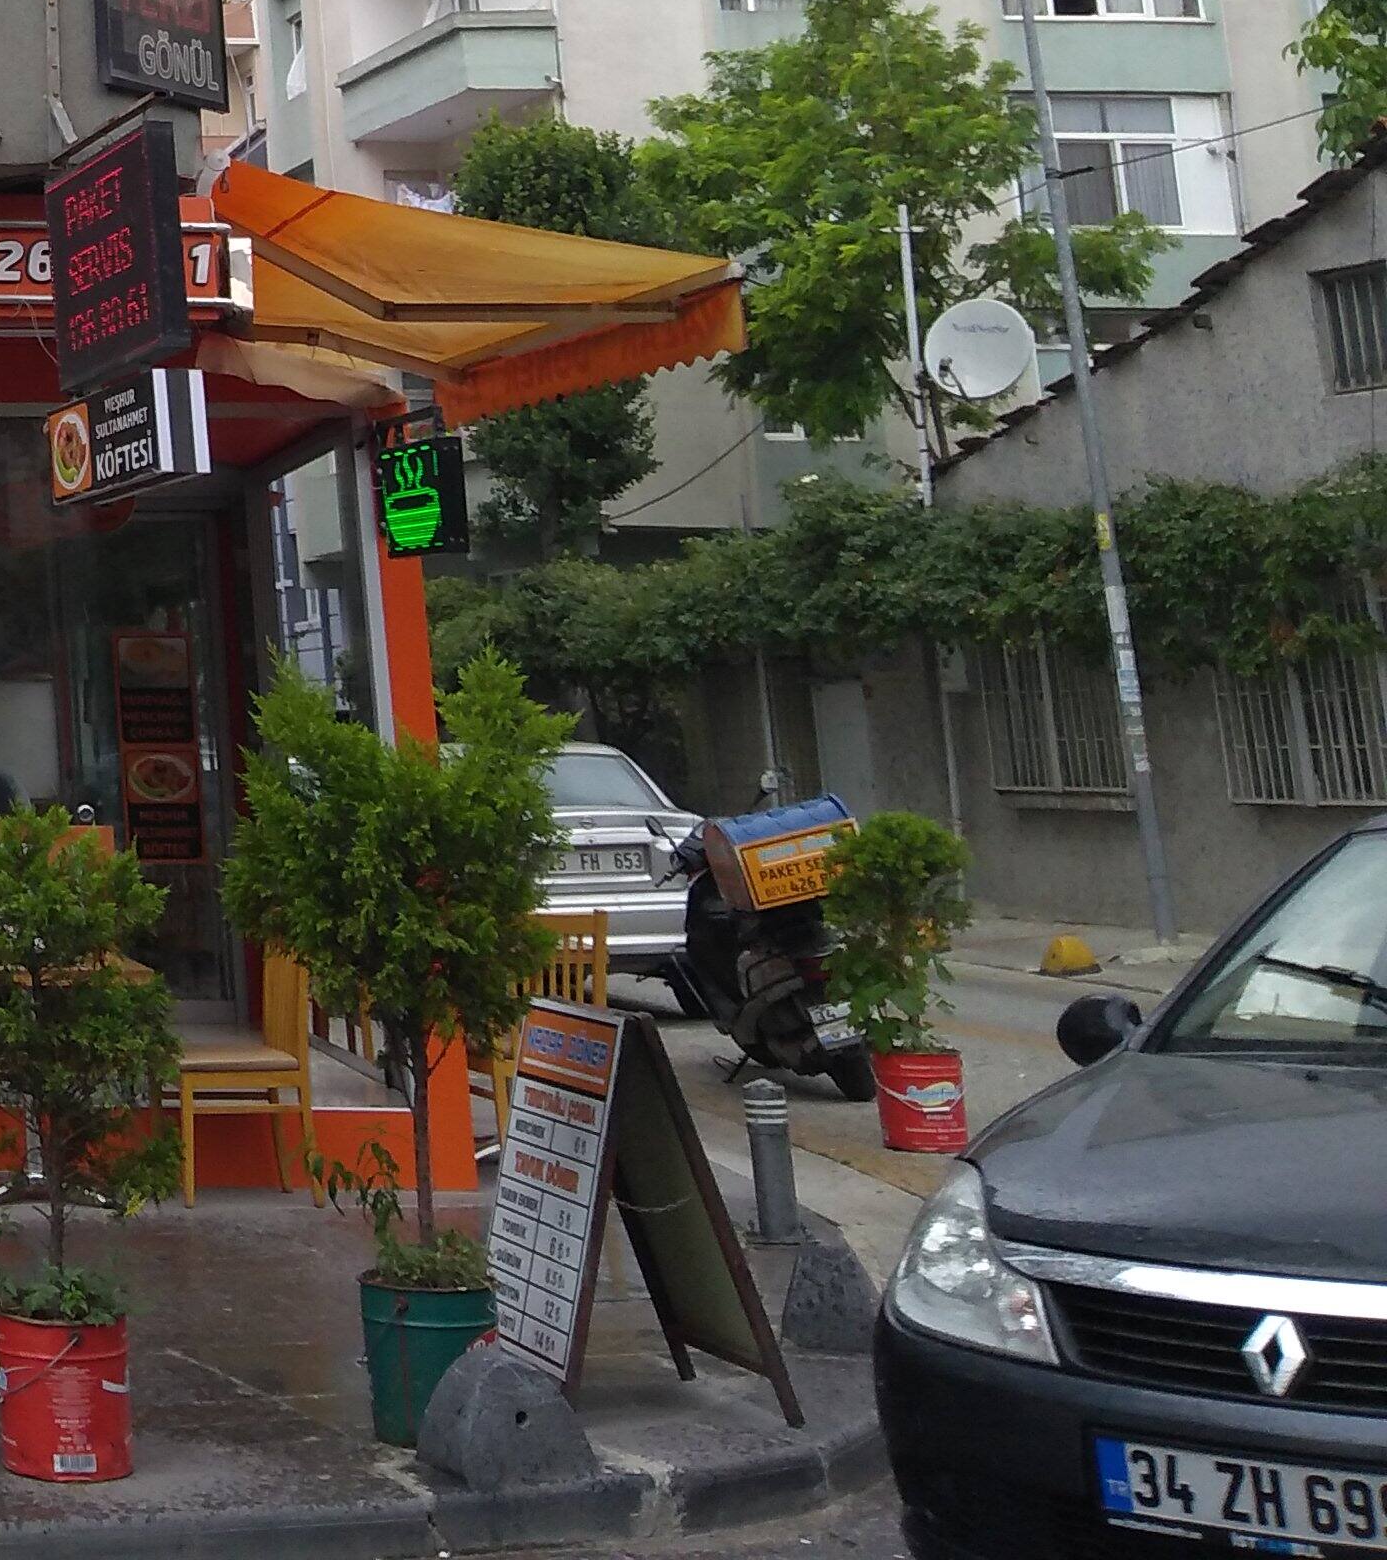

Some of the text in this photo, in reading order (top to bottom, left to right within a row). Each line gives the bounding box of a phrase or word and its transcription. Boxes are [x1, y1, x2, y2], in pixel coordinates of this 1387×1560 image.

[139, 30, 220, 92] GÖNÜL
[189, 243, 212, 285] 1
[104, 388, 136, 414] MEŞHUR
[95, 406, 149, 440] SULTANAHMET
[95, 429, 154, 481] KÖFTESİ
[580, 853, 600, 871] FH
[614, 852, 643, 870] 653
[759, 862, 802, 882] PAKET
[790, 876, 816, 893] 426
[1130, 1449, 1195, 1514] 34
[1215, 1461, 1287, 1529] ZH
[1305, 1474, 1387, 1540] 69
